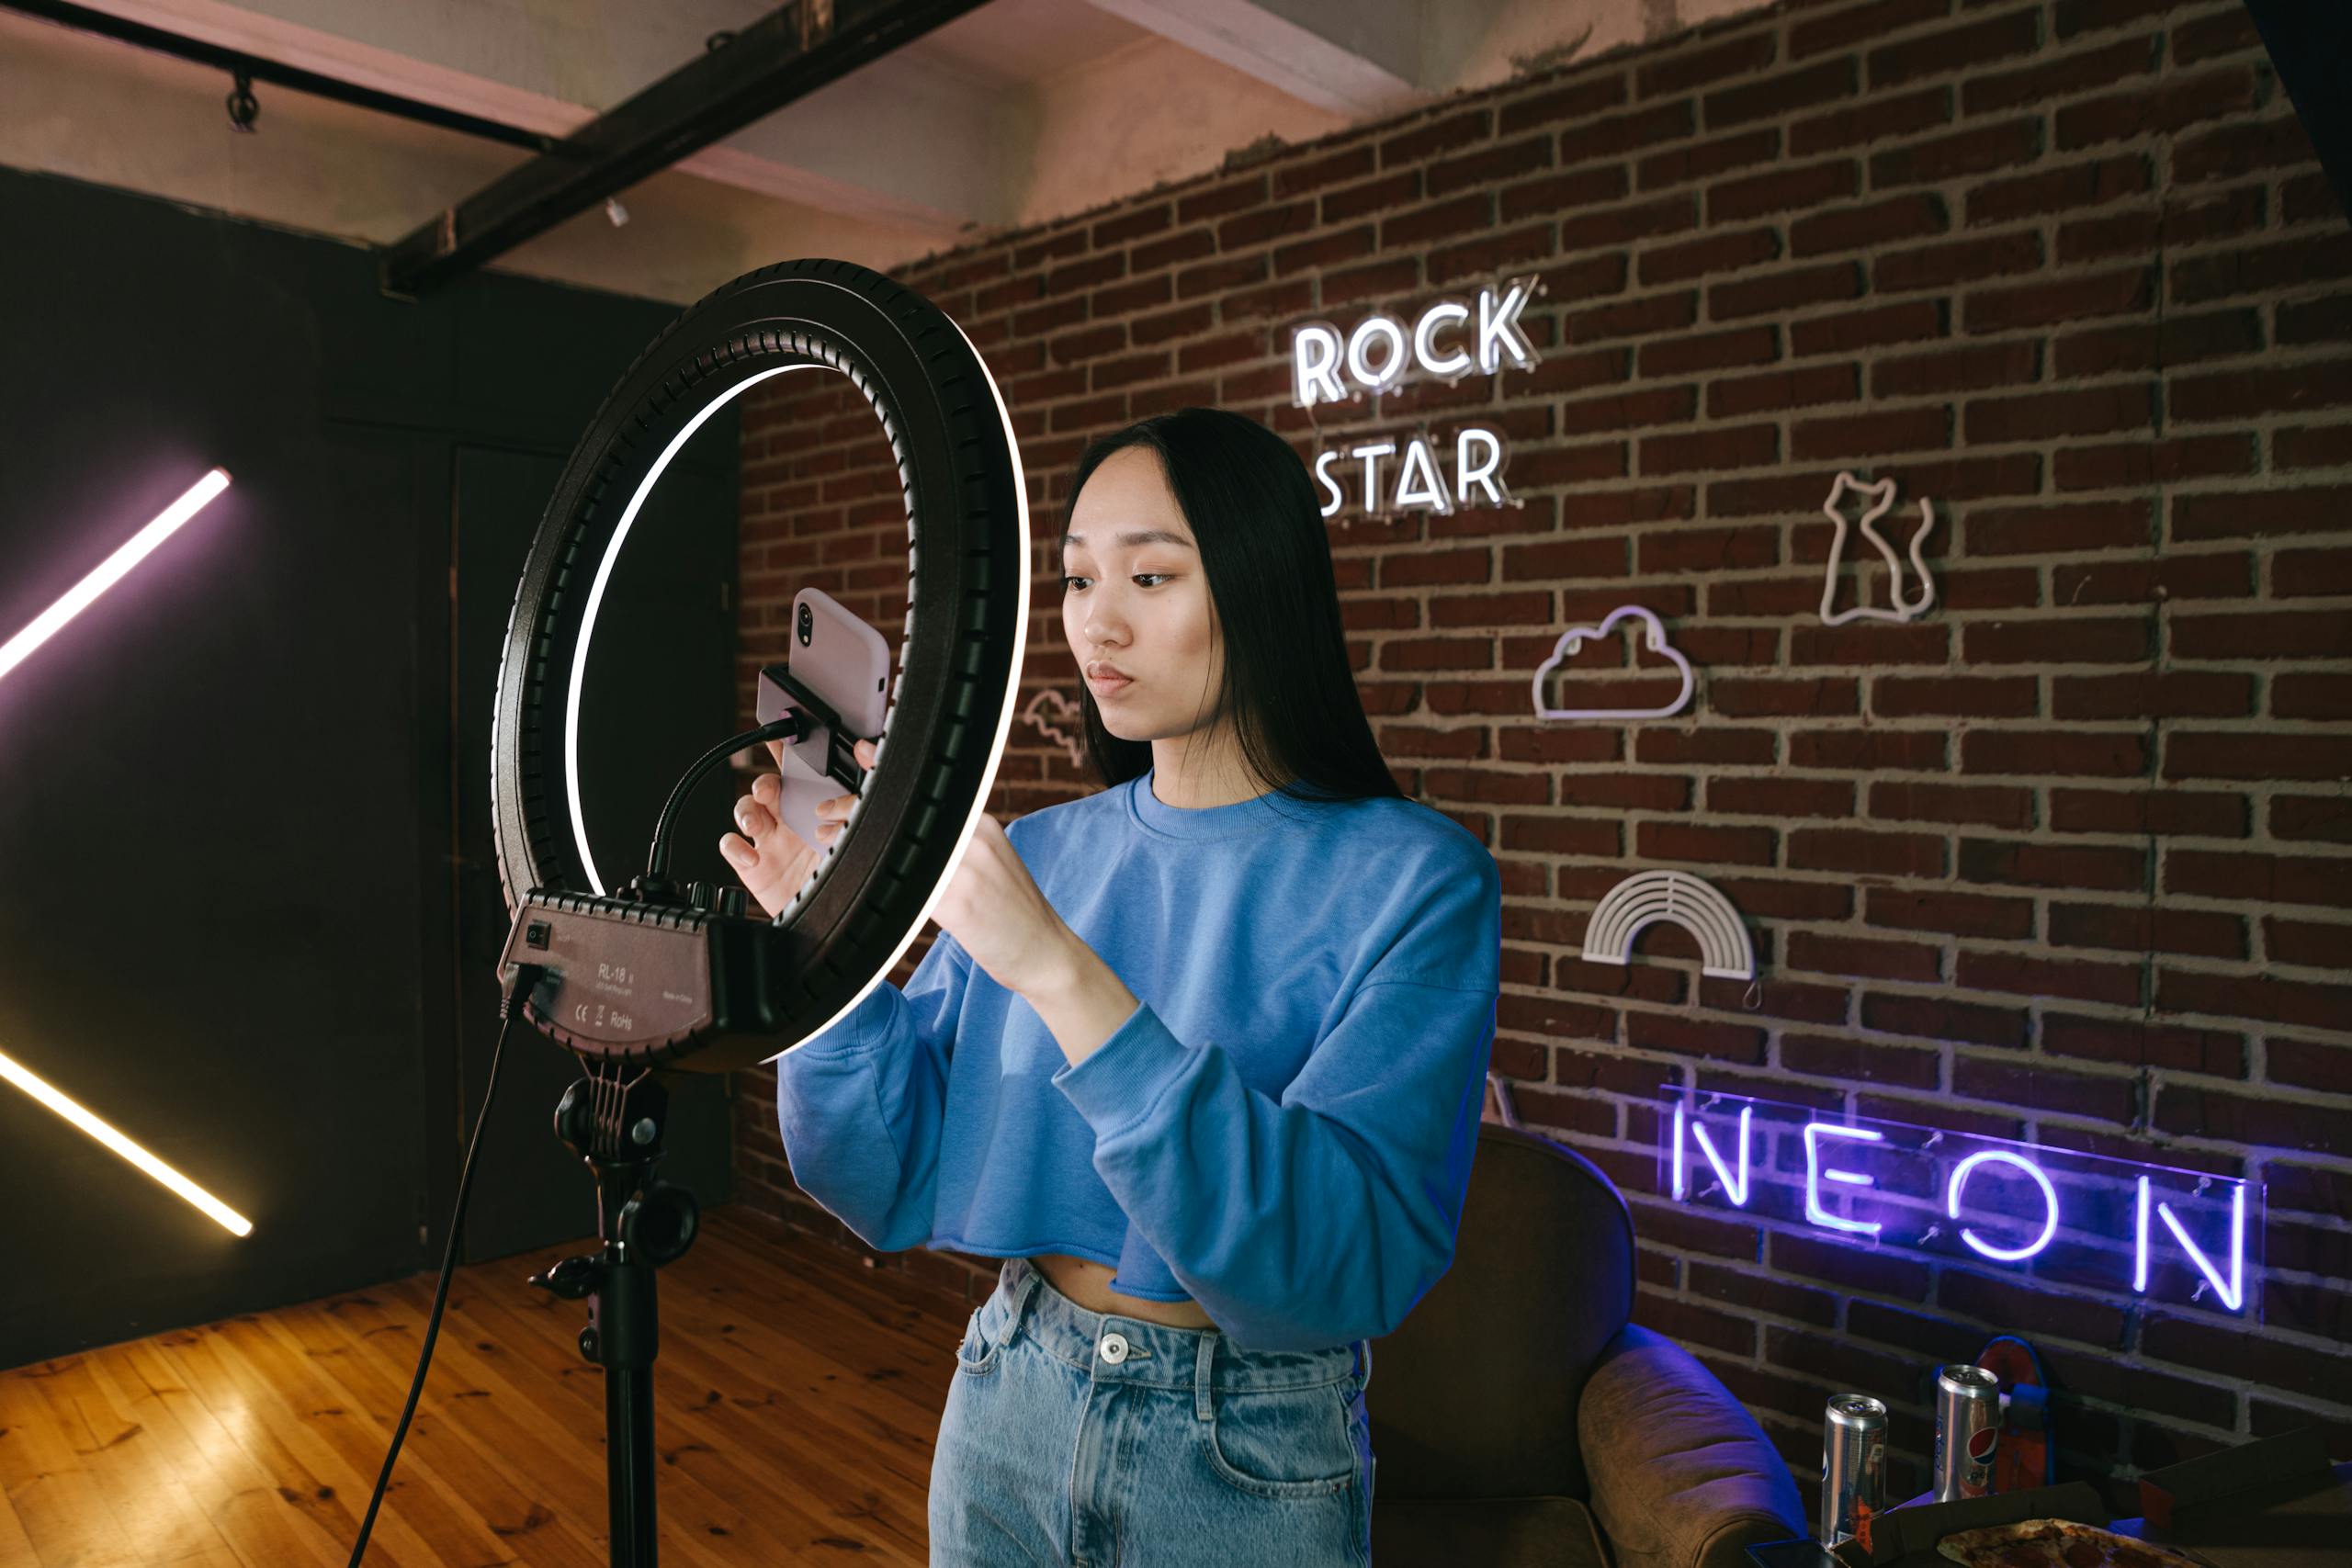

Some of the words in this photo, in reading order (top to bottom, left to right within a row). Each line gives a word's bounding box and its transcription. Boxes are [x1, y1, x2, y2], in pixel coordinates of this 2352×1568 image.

[1294, 285, 1529, 407] ROCK
[1315, 427, 1502, 518] STAR
[597, 963, 626, 984] RL-18
[1671, 1099, 2246, 1312] NEON
